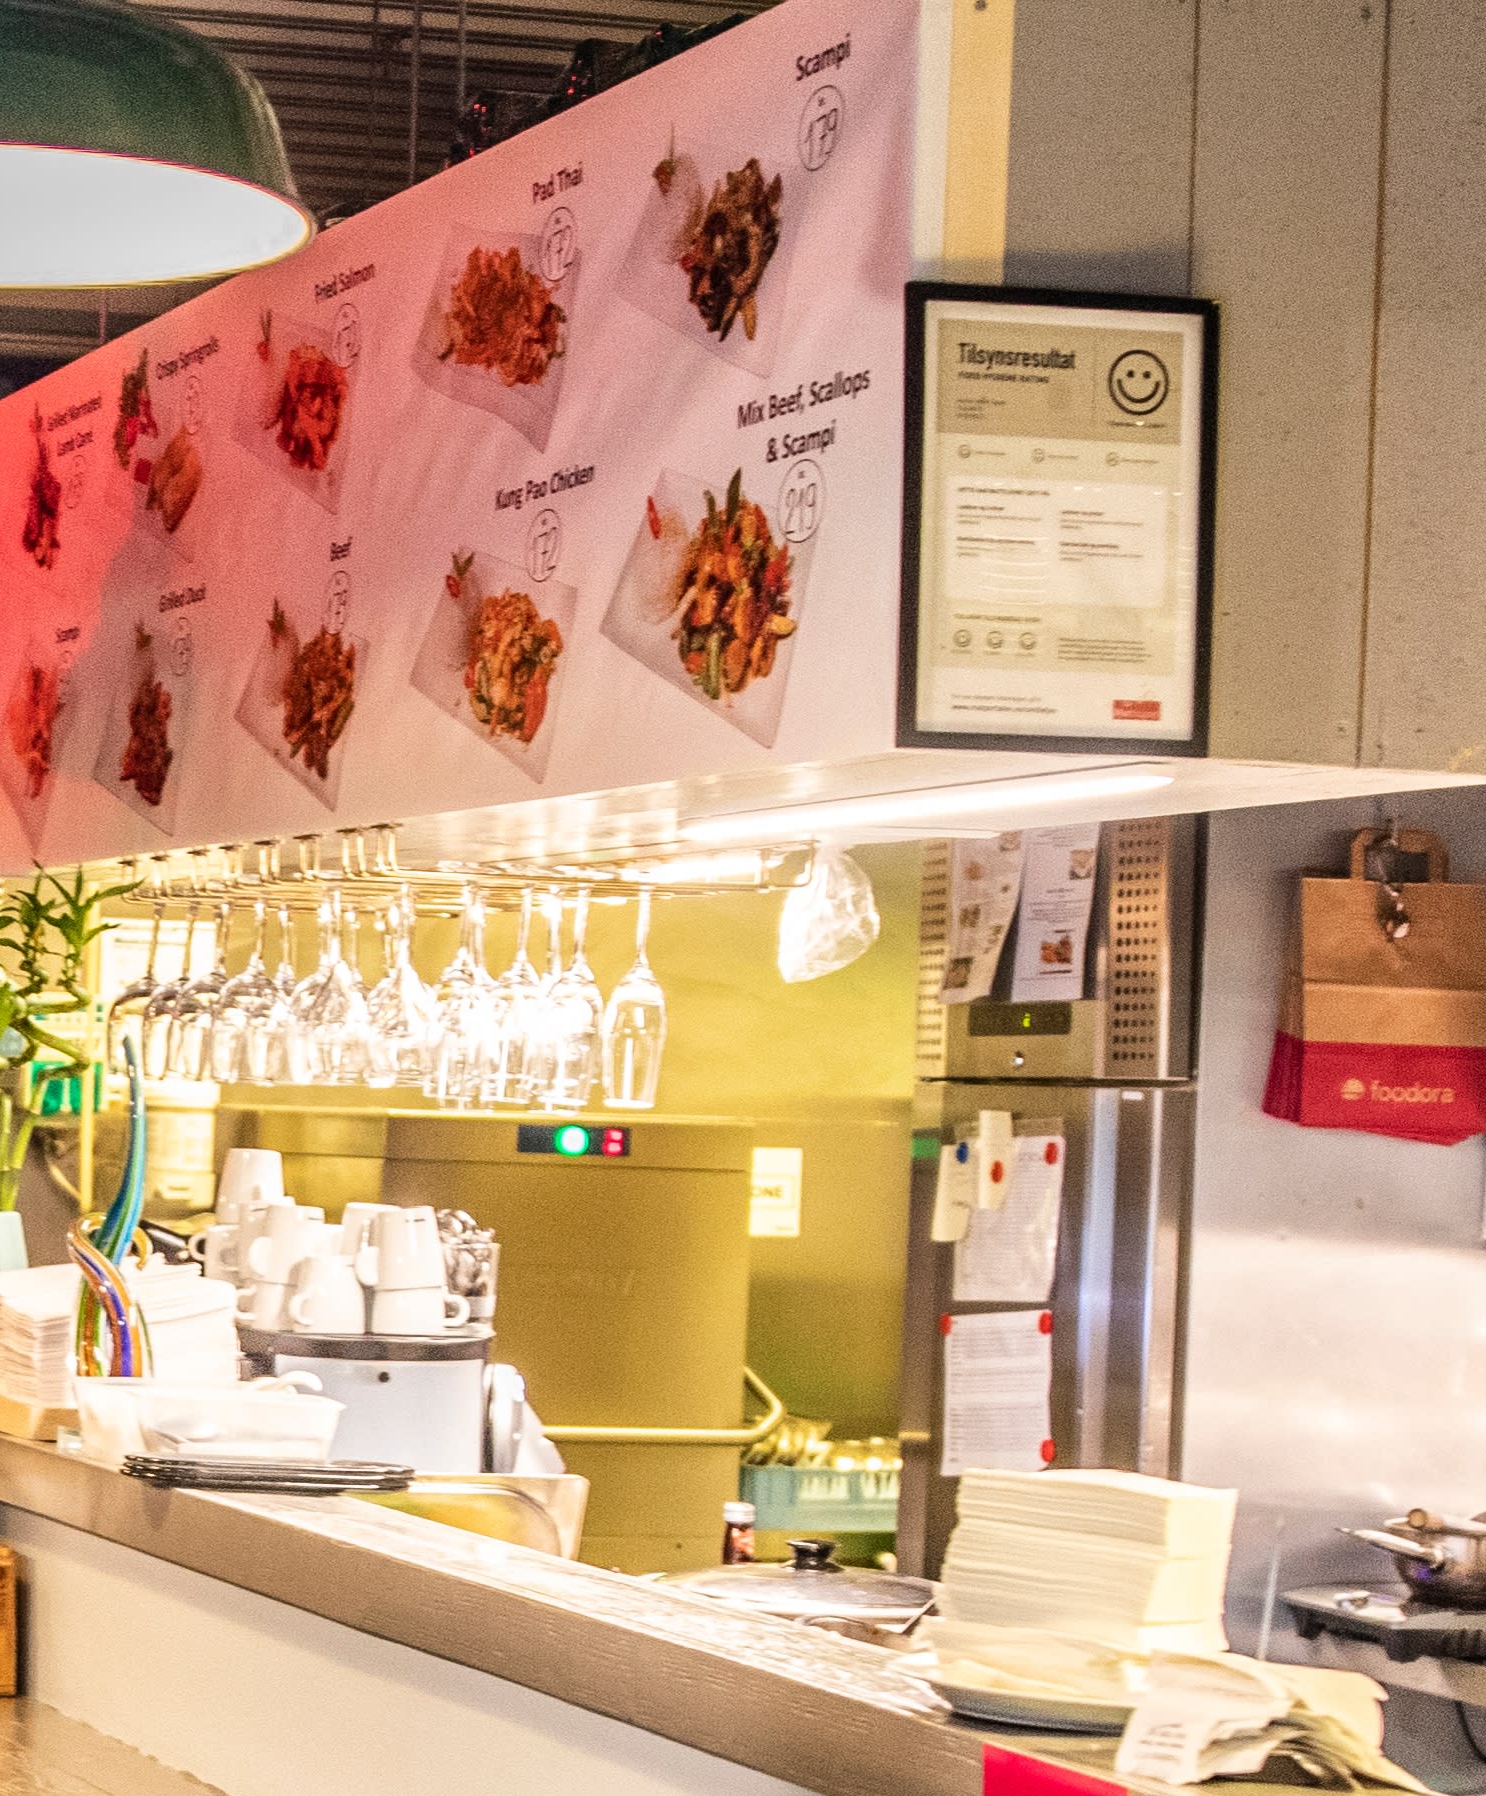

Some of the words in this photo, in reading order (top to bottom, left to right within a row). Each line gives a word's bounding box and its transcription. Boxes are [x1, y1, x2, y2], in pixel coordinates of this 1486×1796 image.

[795, 31, 850, 81] Scampi
[805, 107, 838, 161] 179
[532, 173, 554, 204] Pad
[557, 161, 583, 192] Thai
[314, 274, 338, 304] Fried
[339, 263, 375, 293] Salmon
[957, 342, 1075, 370] Tilsynsresultat
[737, 399, 765, 429] Mix
[769, 384, 805, 419] Beef,
[809, 370, 870, 407] Scallops
[767, 437, 778, 463] &
[782, 418, 837, 459] Scampi
[495, 487, 523, 510] Kung
[526, 480, 547, 501] Pao
[550, 465, 594, 494] Chicken
[785, 482, 817, 535] 219
[330, 536, 353, 561] Beef
[1371, 1080, 1455, 1104] foodora
